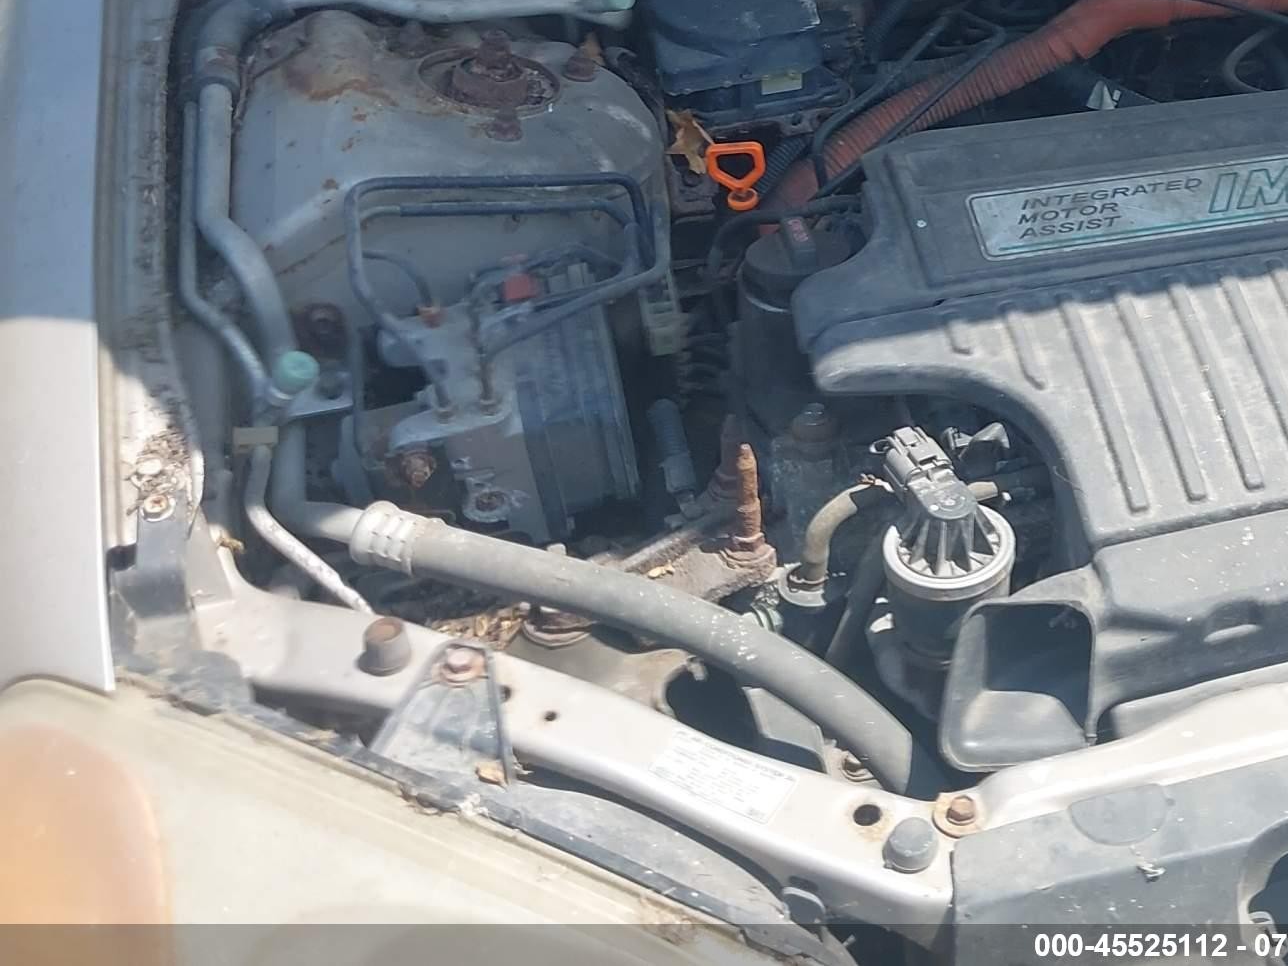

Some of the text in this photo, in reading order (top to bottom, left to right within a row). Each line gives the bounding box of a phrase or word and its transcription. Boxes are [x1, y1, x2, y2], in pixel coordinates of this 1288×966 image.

[1021, 177, 1203, 211] INTEGRATED
[1017, 202, 1119, 225] MOTOR
[1018, 215, 1122, 240] ASSIST
